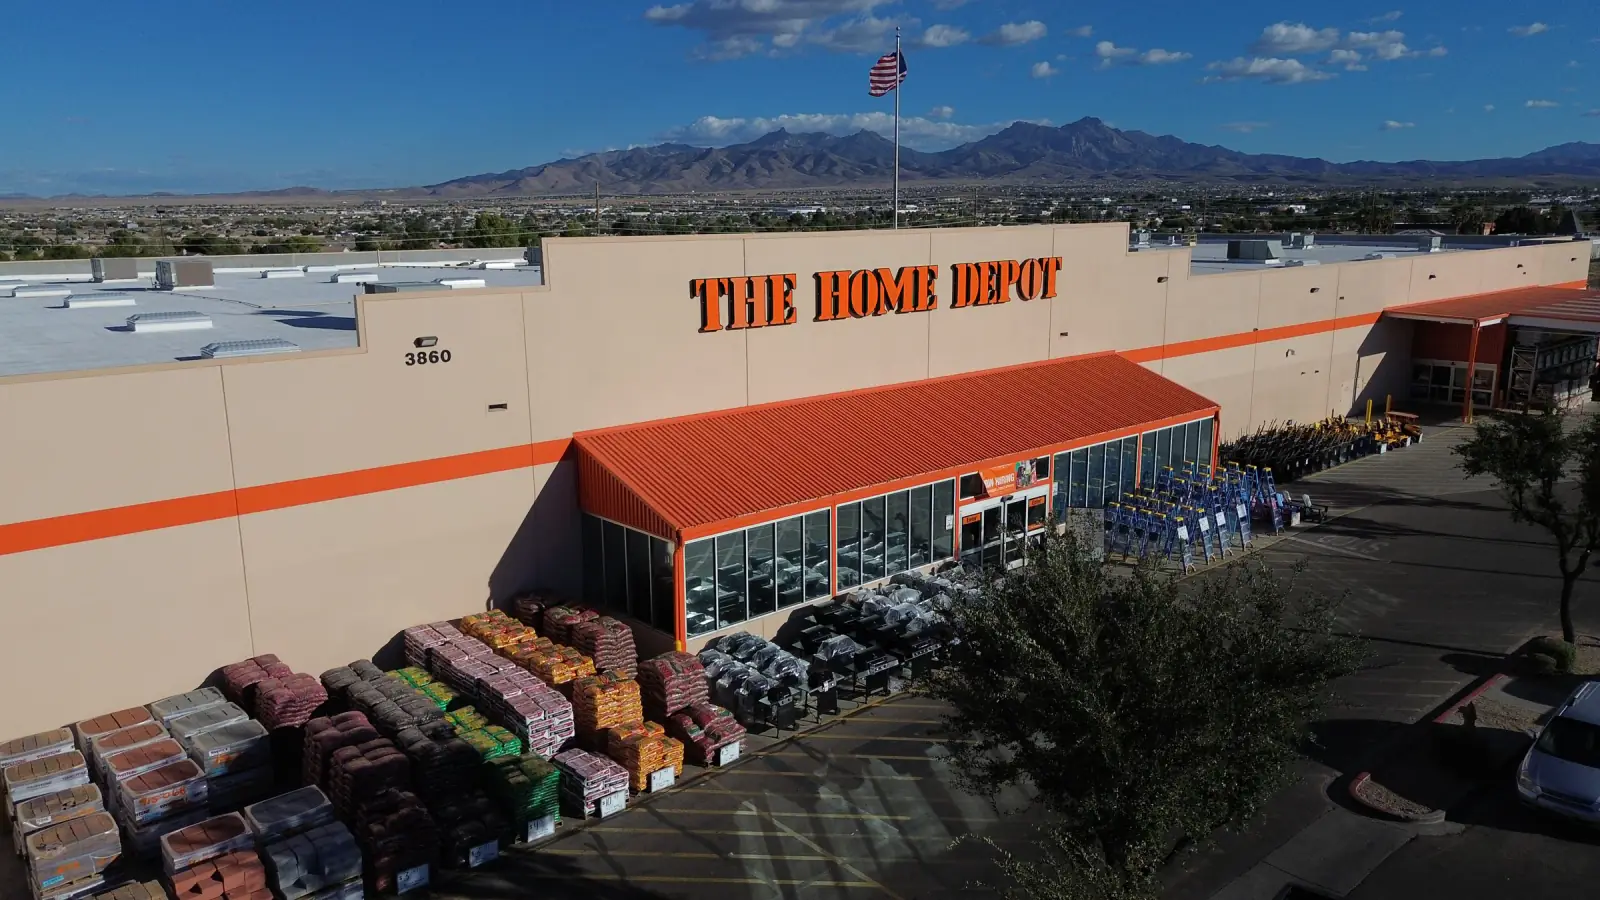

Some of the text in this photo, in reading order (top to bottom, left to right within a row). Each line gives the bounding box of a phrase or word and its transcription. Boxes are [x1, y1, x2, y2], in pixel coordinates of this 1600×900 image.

[689, 257, 1062, 333] THE HOME DEPOT
[405, 349, 451, 366] 3860
